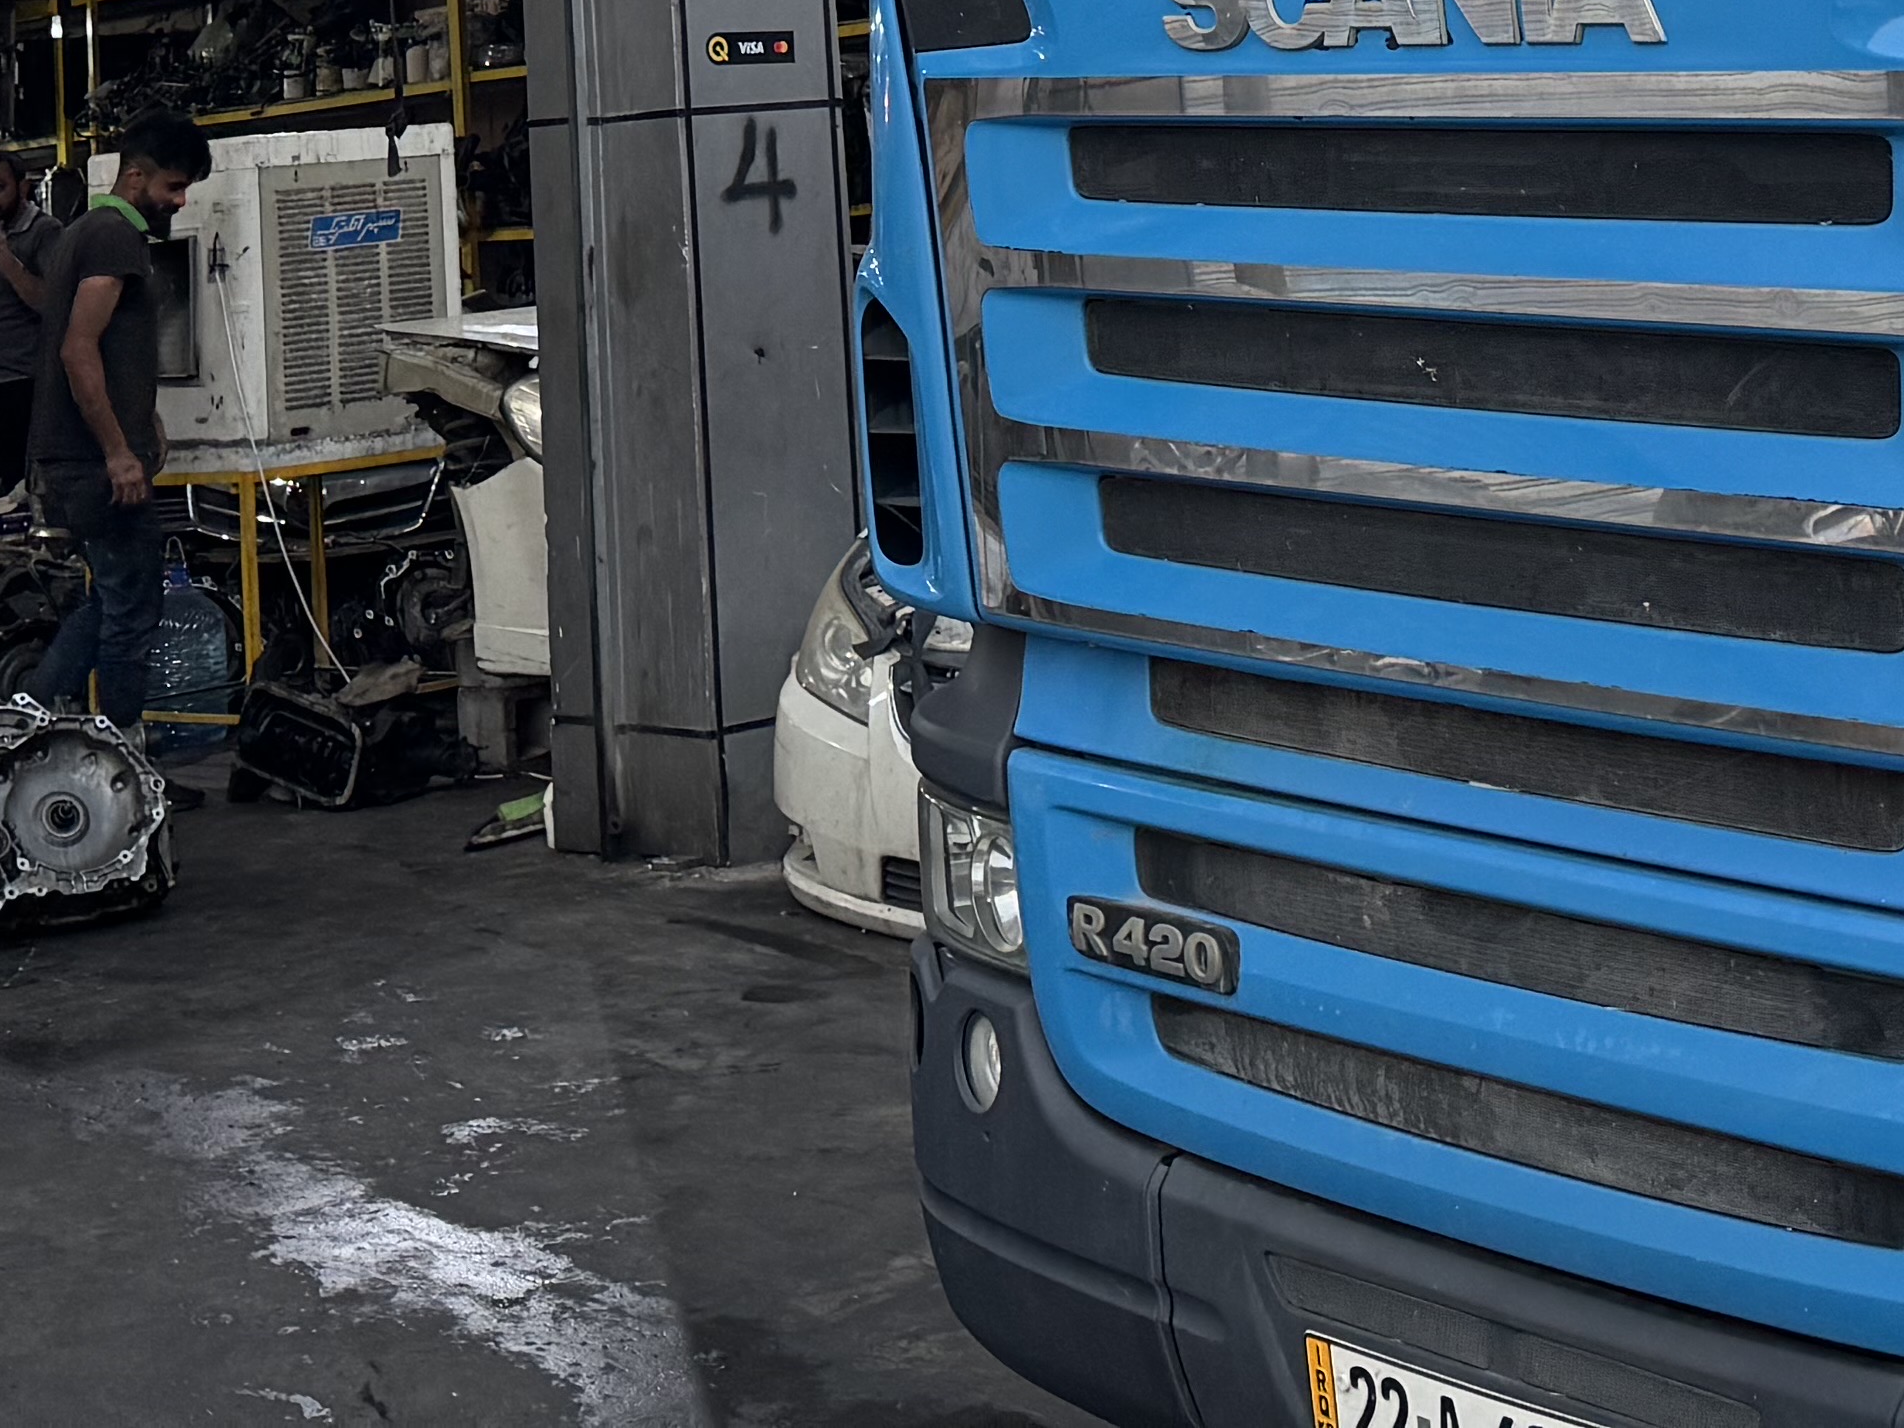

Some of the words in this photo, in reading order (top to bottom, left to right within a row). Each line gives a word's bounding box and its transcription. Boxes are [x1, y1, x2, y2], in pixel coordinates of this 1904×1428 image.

[737, 41, 765, 55] VISA
[720, 115, 798, 236] 4
[1072, 903, 1110, 957] R
[1112, 915, 1222, 986] 420
